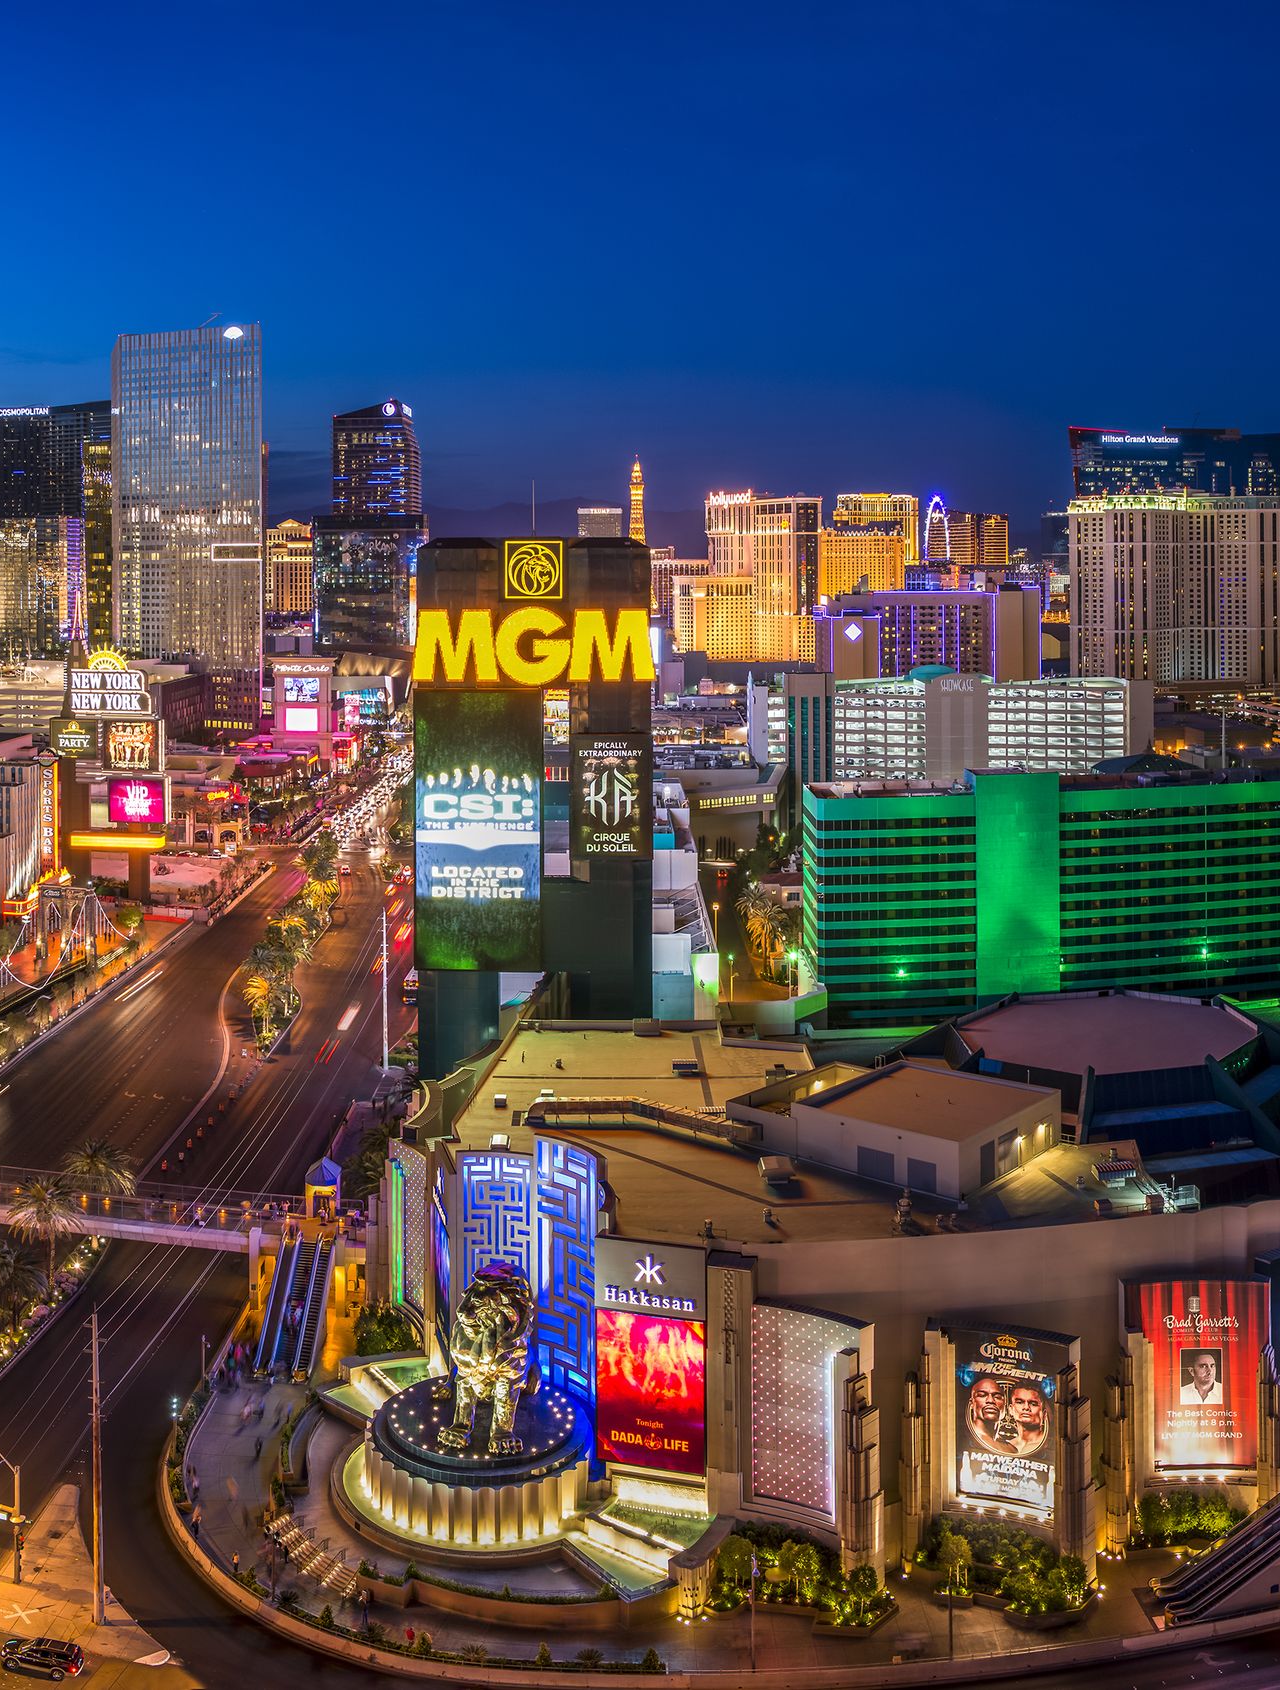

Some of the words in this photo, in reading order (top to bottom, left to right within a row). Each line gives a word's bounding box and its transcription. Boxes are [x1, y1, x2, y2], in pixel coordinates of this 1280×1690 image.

[1102, 435, 1123, 443] Hilton
[1125, 435, 1145, 443] Grand
[710, 489, 751, 509] hollywood
[412, 606, 656, 686] MGM
[71, 672, 102, 690] NEW
[104, 672, 141, 690] YORK
[940, 679, 974, 692] SHOWCASE
[71, 693, 102, 710] NEW
[104, 694, 141, 711] YORK
[42, 768, 53, 822] SPORTS
[126, 785, 148, 798] VIP
[423, 793, 534, 820] CSI:
[425, 821, 450, 829] THE
[42, 826, 54, 854] BAR
[593, 833, 631, 844] CIRQUE
[586, 844, 600, 852] DU
[603, 844, 637, 852] SOLEIL
[431, 866, 524, 879] LOCATED
[451, 878, 467, 886] IN
[470, 879, 500, 887] THE
[431, 886, 526, 899] DISTRICT
[604, 1286, 695, 1312] Hakkasan
[1163, 1314, 1193, 1329] Brad
[1194, 1314, 1239, 1333] Garrett's
[980, 1343, 1031, 1361] Corona
[972, 1361, 1048, 1382] MOMENT
[1166, 1410, 1182, 1418] The
[1184, 1409, 1204, 1417] Best
[1206, 1409, 1238, 1417] Comics
[635, 1418, 664, 1429] Tonight
[611, 1430, 644, 1446] DADA
[664, 1438, 689, 1452] LIFE
[1214, 1431, 1243, 1439] GRAND
[970, 1451, 1049, 1472] MAYWEATHER
[982, 1462, 1038, 1480] MAIDANA
